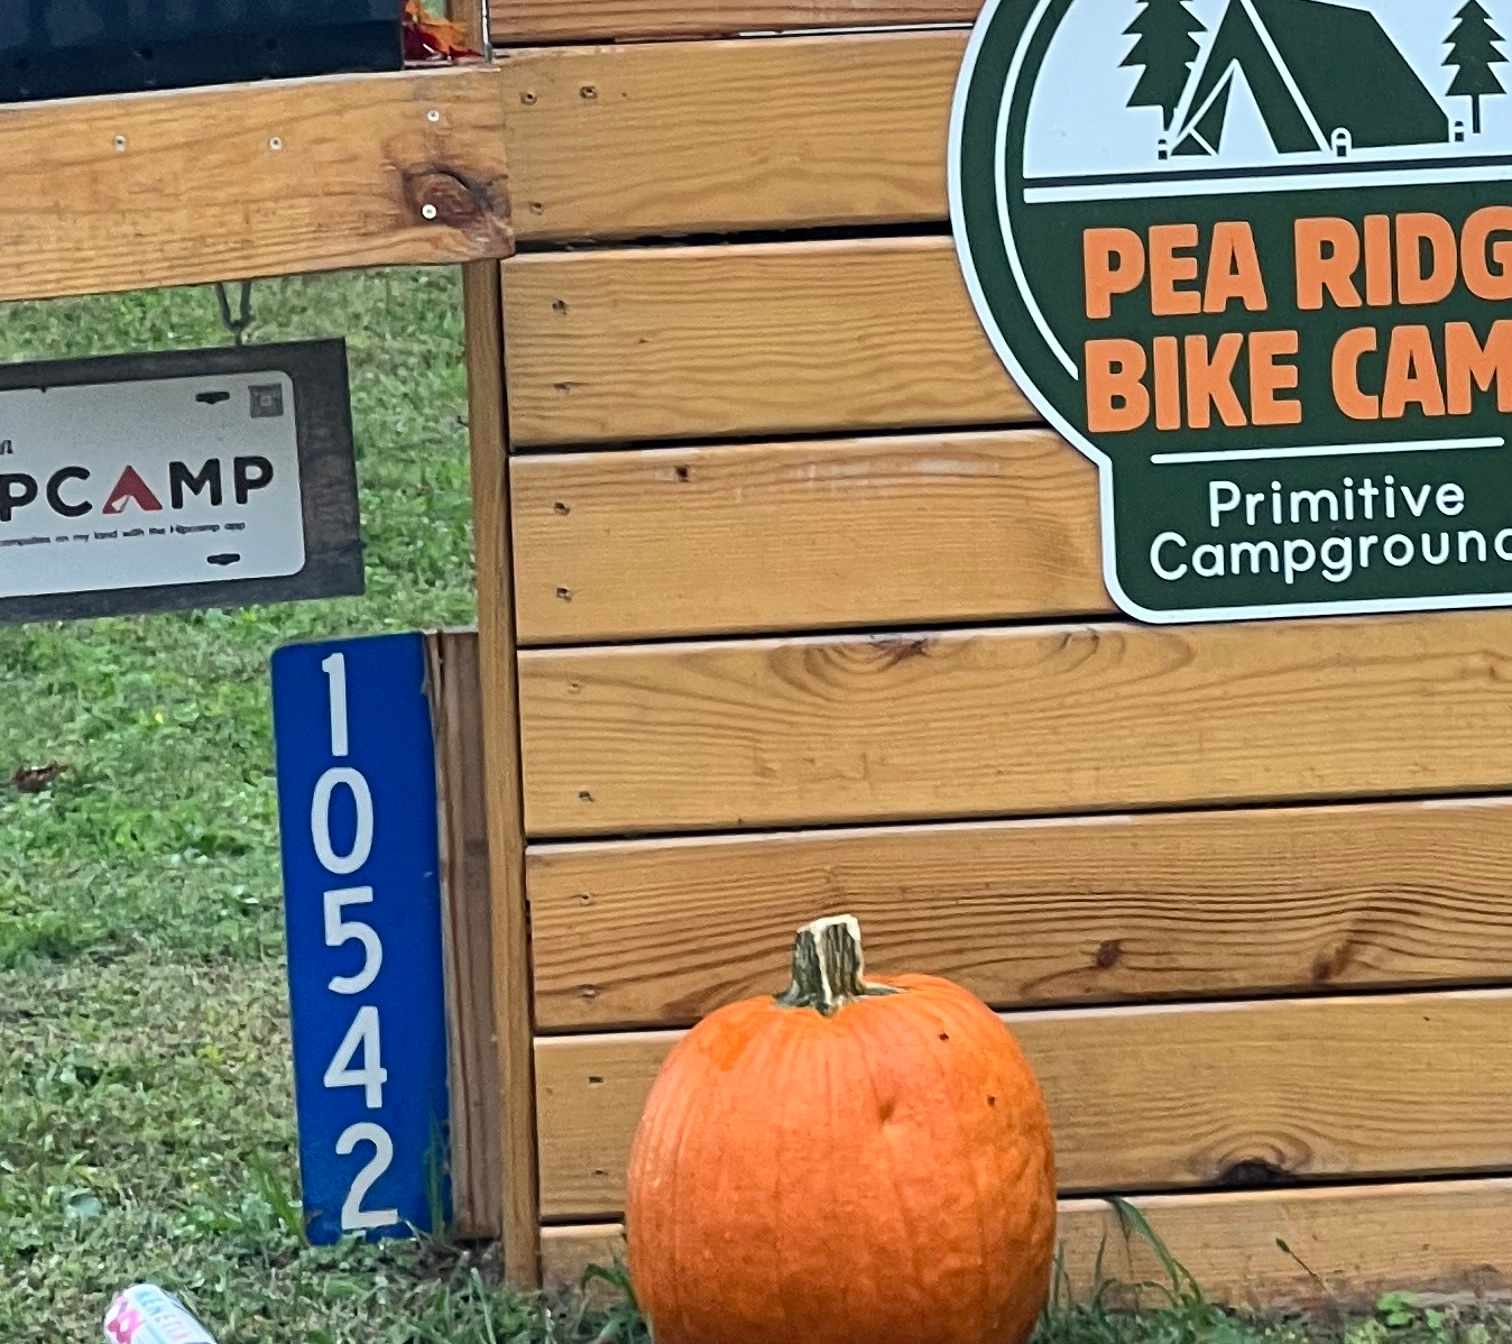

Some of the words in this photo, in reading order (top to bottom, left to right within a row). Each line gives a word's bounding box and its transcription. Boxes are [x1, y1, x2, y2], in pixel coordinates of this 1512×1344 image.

[1082, 220, 1268, 319] PEA
[1084, 329, 1302, 433] BIKE
[1208, 474, 1465, 527] Primitive
[310, 651, 399, 1230] 10542
